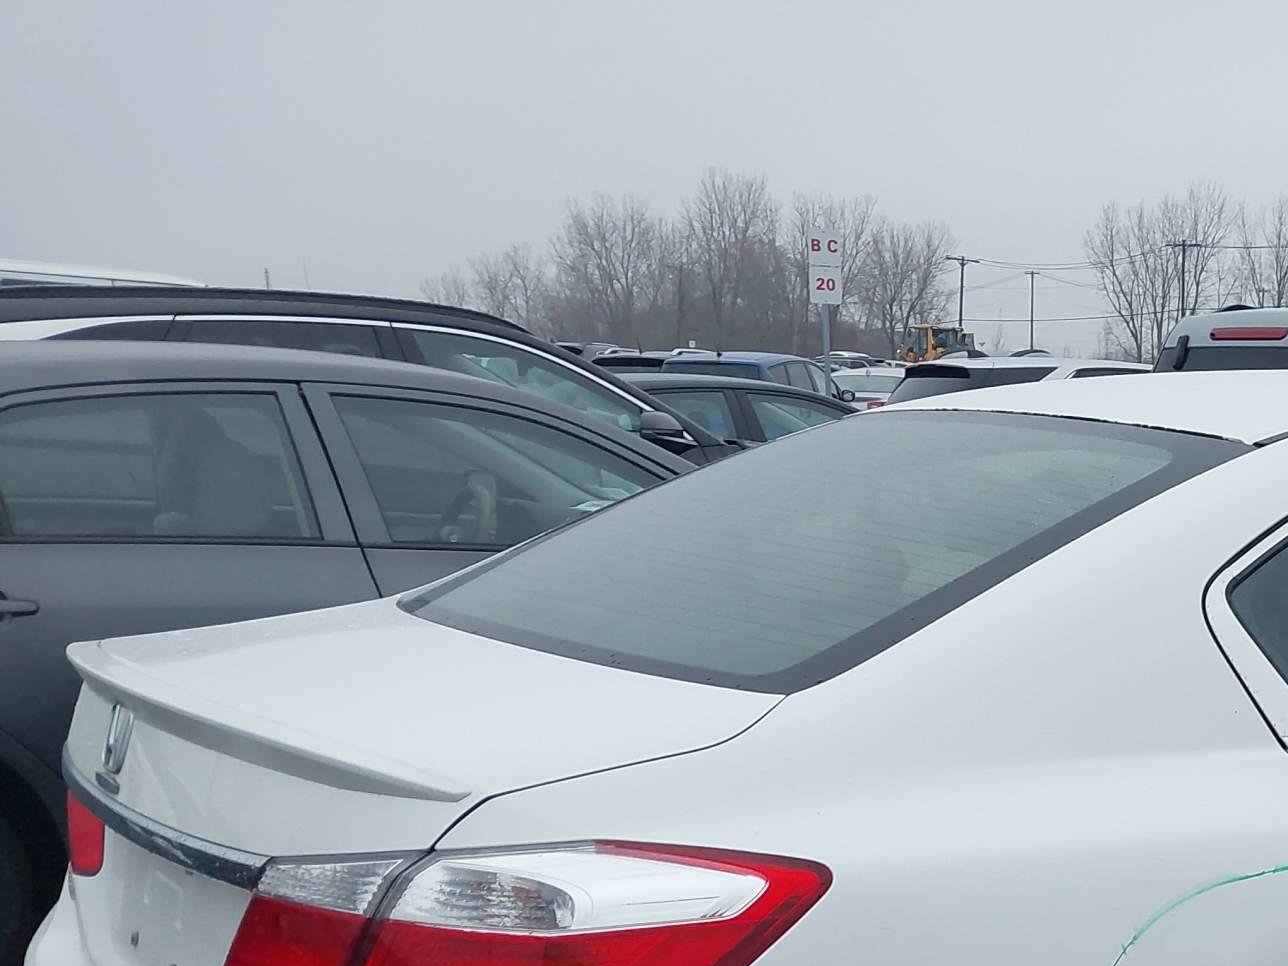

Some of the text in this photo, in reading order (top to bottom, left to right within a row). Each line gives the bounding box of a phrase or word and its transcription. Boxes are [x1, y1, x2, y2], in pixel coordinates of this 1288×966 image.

[811, 239, 838, 253] B C
[815, 278, 836, 291] 20
